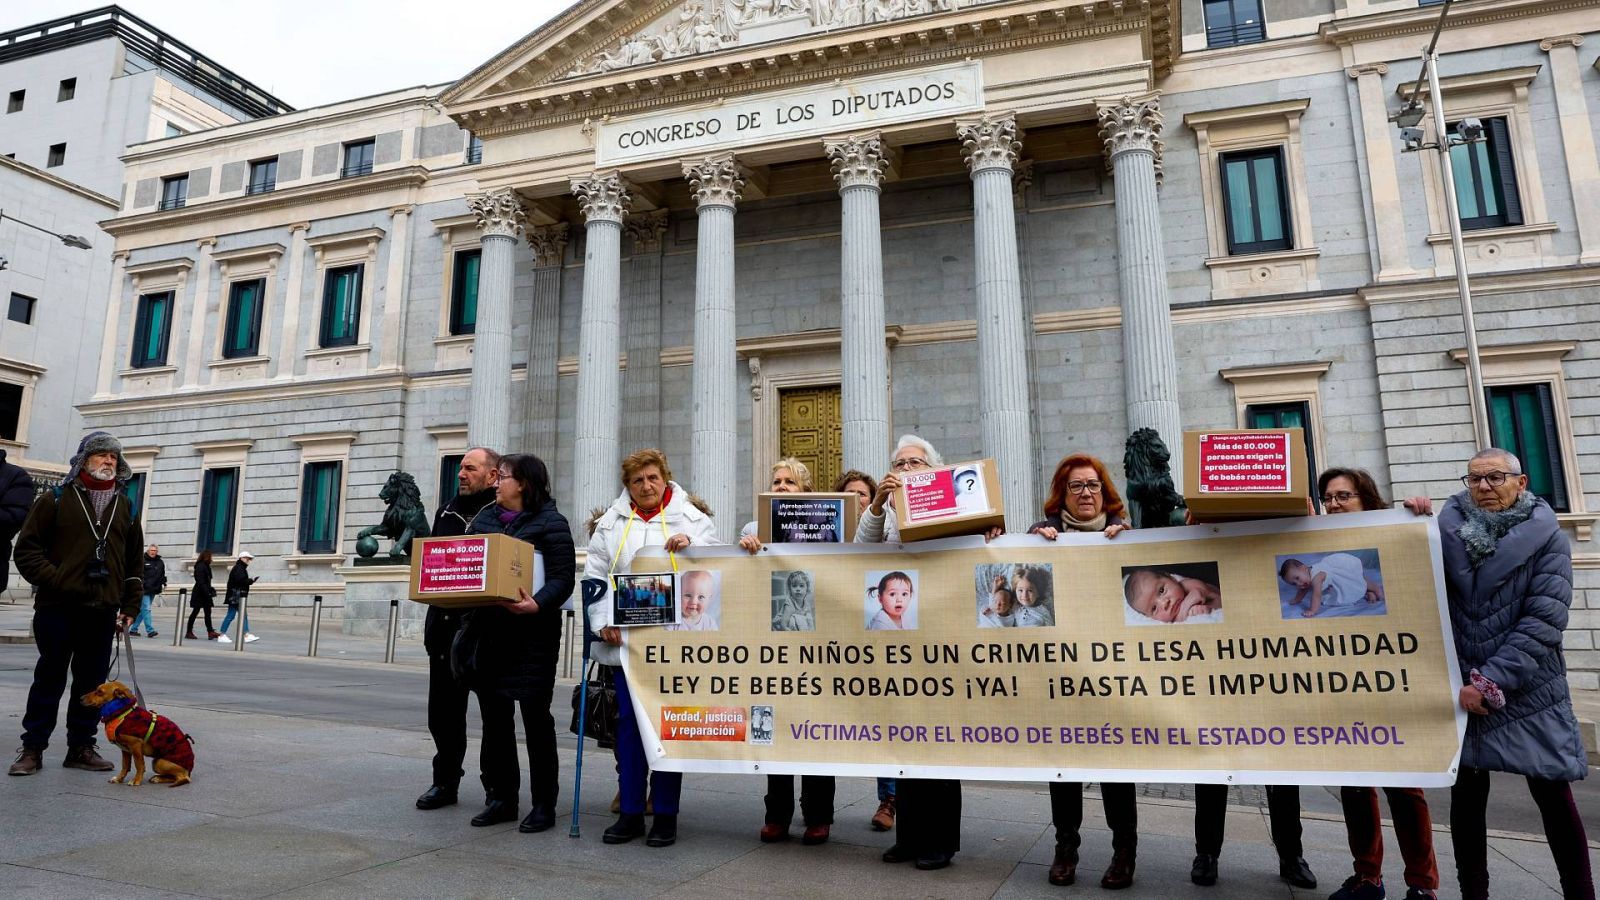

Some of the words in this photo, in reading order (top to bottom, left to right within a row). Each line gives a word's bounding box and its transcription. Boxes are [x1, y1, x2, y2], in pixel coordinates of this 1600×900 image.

[618, 118, 722, 149] CONGRESO
[736, 111, 761, 131] DE
[776, 104, 815, 125] LOS
[831, 82, 955, 117] DIPUTADOS
[1205, 463, 1250, 471] aprobación
[907, 474, 935, 483] 80.000
[966, 479, 974, 490] ?
[645, 645, 670, 664] EL
[681, 645, 749, 664] ROBO
[760, 645, 788, 664] DE
[800, 641, 875, 664] NIÑOS
[886, 645, 912, 664] ES
[923, 644, 959, 664] UN
[971, 642, 1078, 664] CRIMEN
[1091, 641, 1124, 663] DE
[1138, 640, 1204, 662] LESA
[1217, 632, 1418, 660] HUMANIDAD
[659, 676, 699, 694] LEY
[710, 676, 739, 695] DE
[750, 672, 822, 696] BEBÉS
[833, 676, 954, 697] ROBADOS
[965, 676, 1019, 699] ¡YA!
[1048, 676, 1148, 699] ¡BASTA
[1160, 675, 1196, 696] DE
[1209, 669, 1409, 696] IMPUNIDAD!
[663, 711, 702, 722] Verdad,
[704, 711, 743, 724] justicia
[671, 726, 677, 737] y
[680, 725, 735, 737] reparación
[790, 720, 882, 741] VÍCTIMAS
[888, 725, 927, 742] POR
[934, 726, 955, 743] EL
[962, 726, 1019, 743] ROBO
[1026, 727, 1053, 744] DE
[1060, 723, 1123, 745] BEBÉS
[1131, 727, 1159, 744] EN
[1168, 727, 1191, 745] EL
[1198, 727, 1286, 745] ESTADO
[1295, 722, 1404, 745] ESPAÑOL
